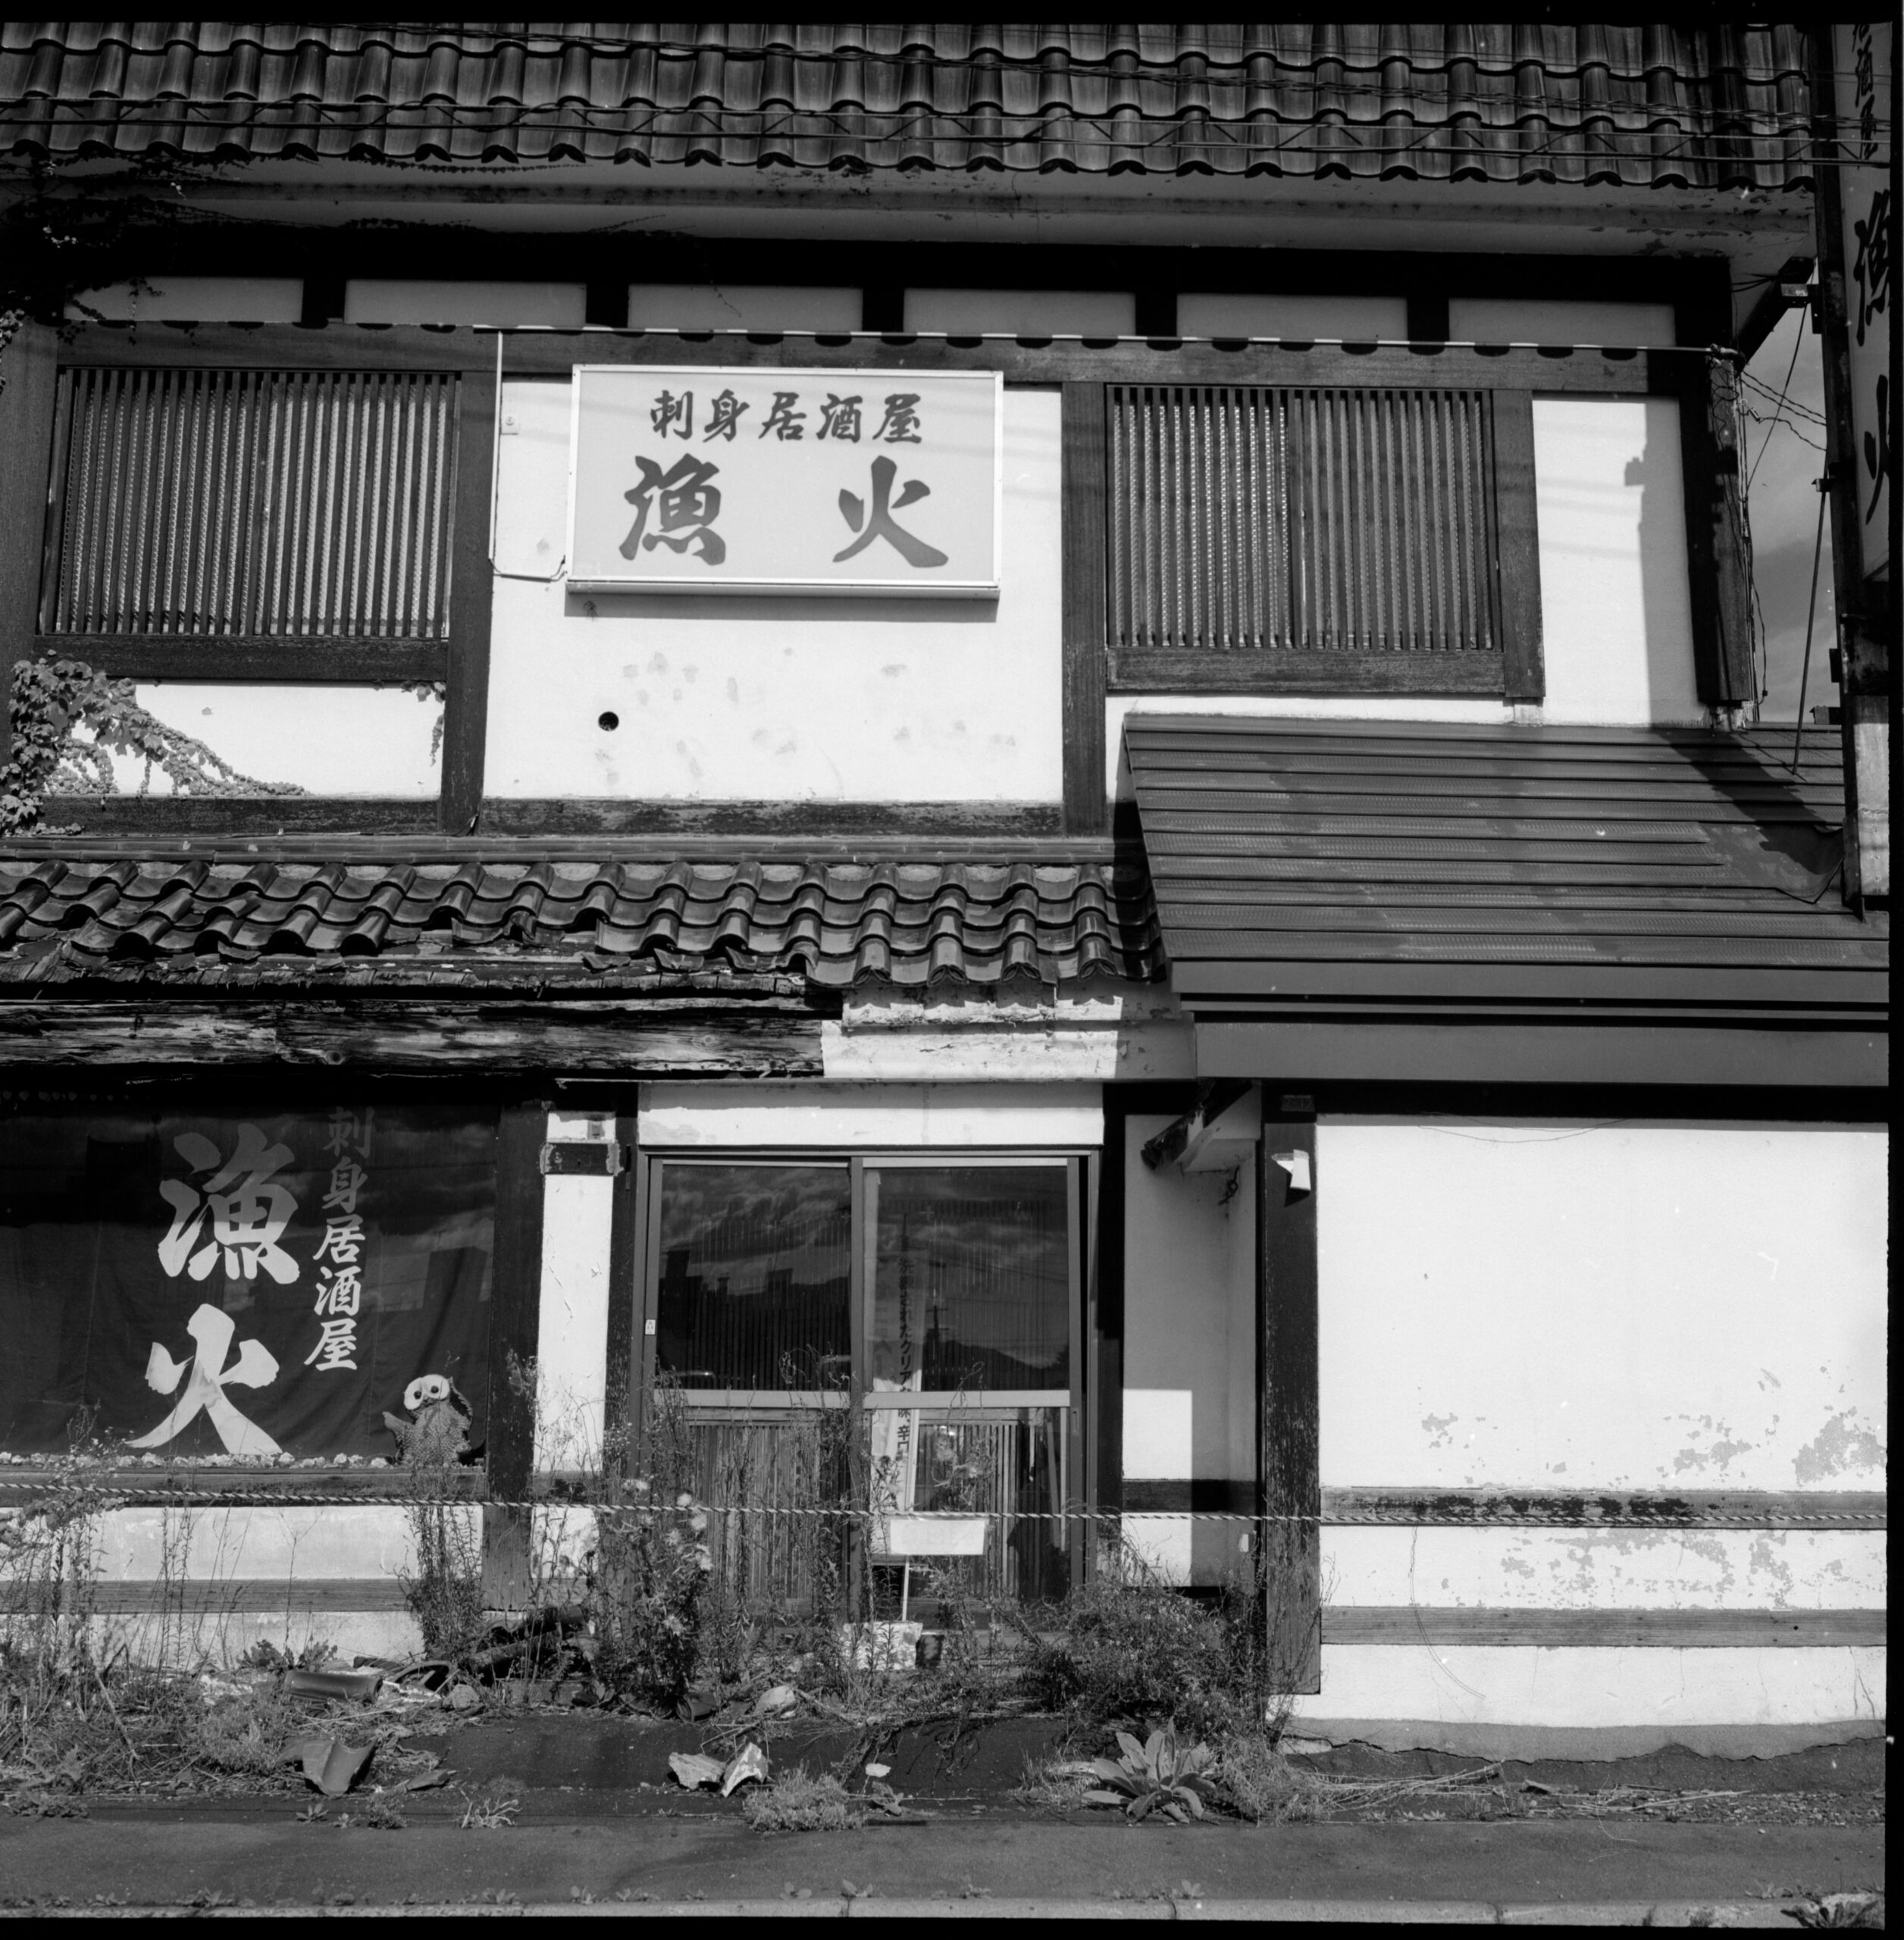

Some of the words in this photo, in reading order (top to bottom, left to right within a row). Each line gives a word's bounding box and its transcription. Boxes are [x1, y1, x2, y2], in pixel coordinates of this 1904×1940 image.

[618, 453, 949, 568] 漁火
[650, 389, 922, 444] 刺身居酒屋
[124, 1122, 300, 1454] 漁火
[304, 1106, 374, 1371] 刺身居酒屋
